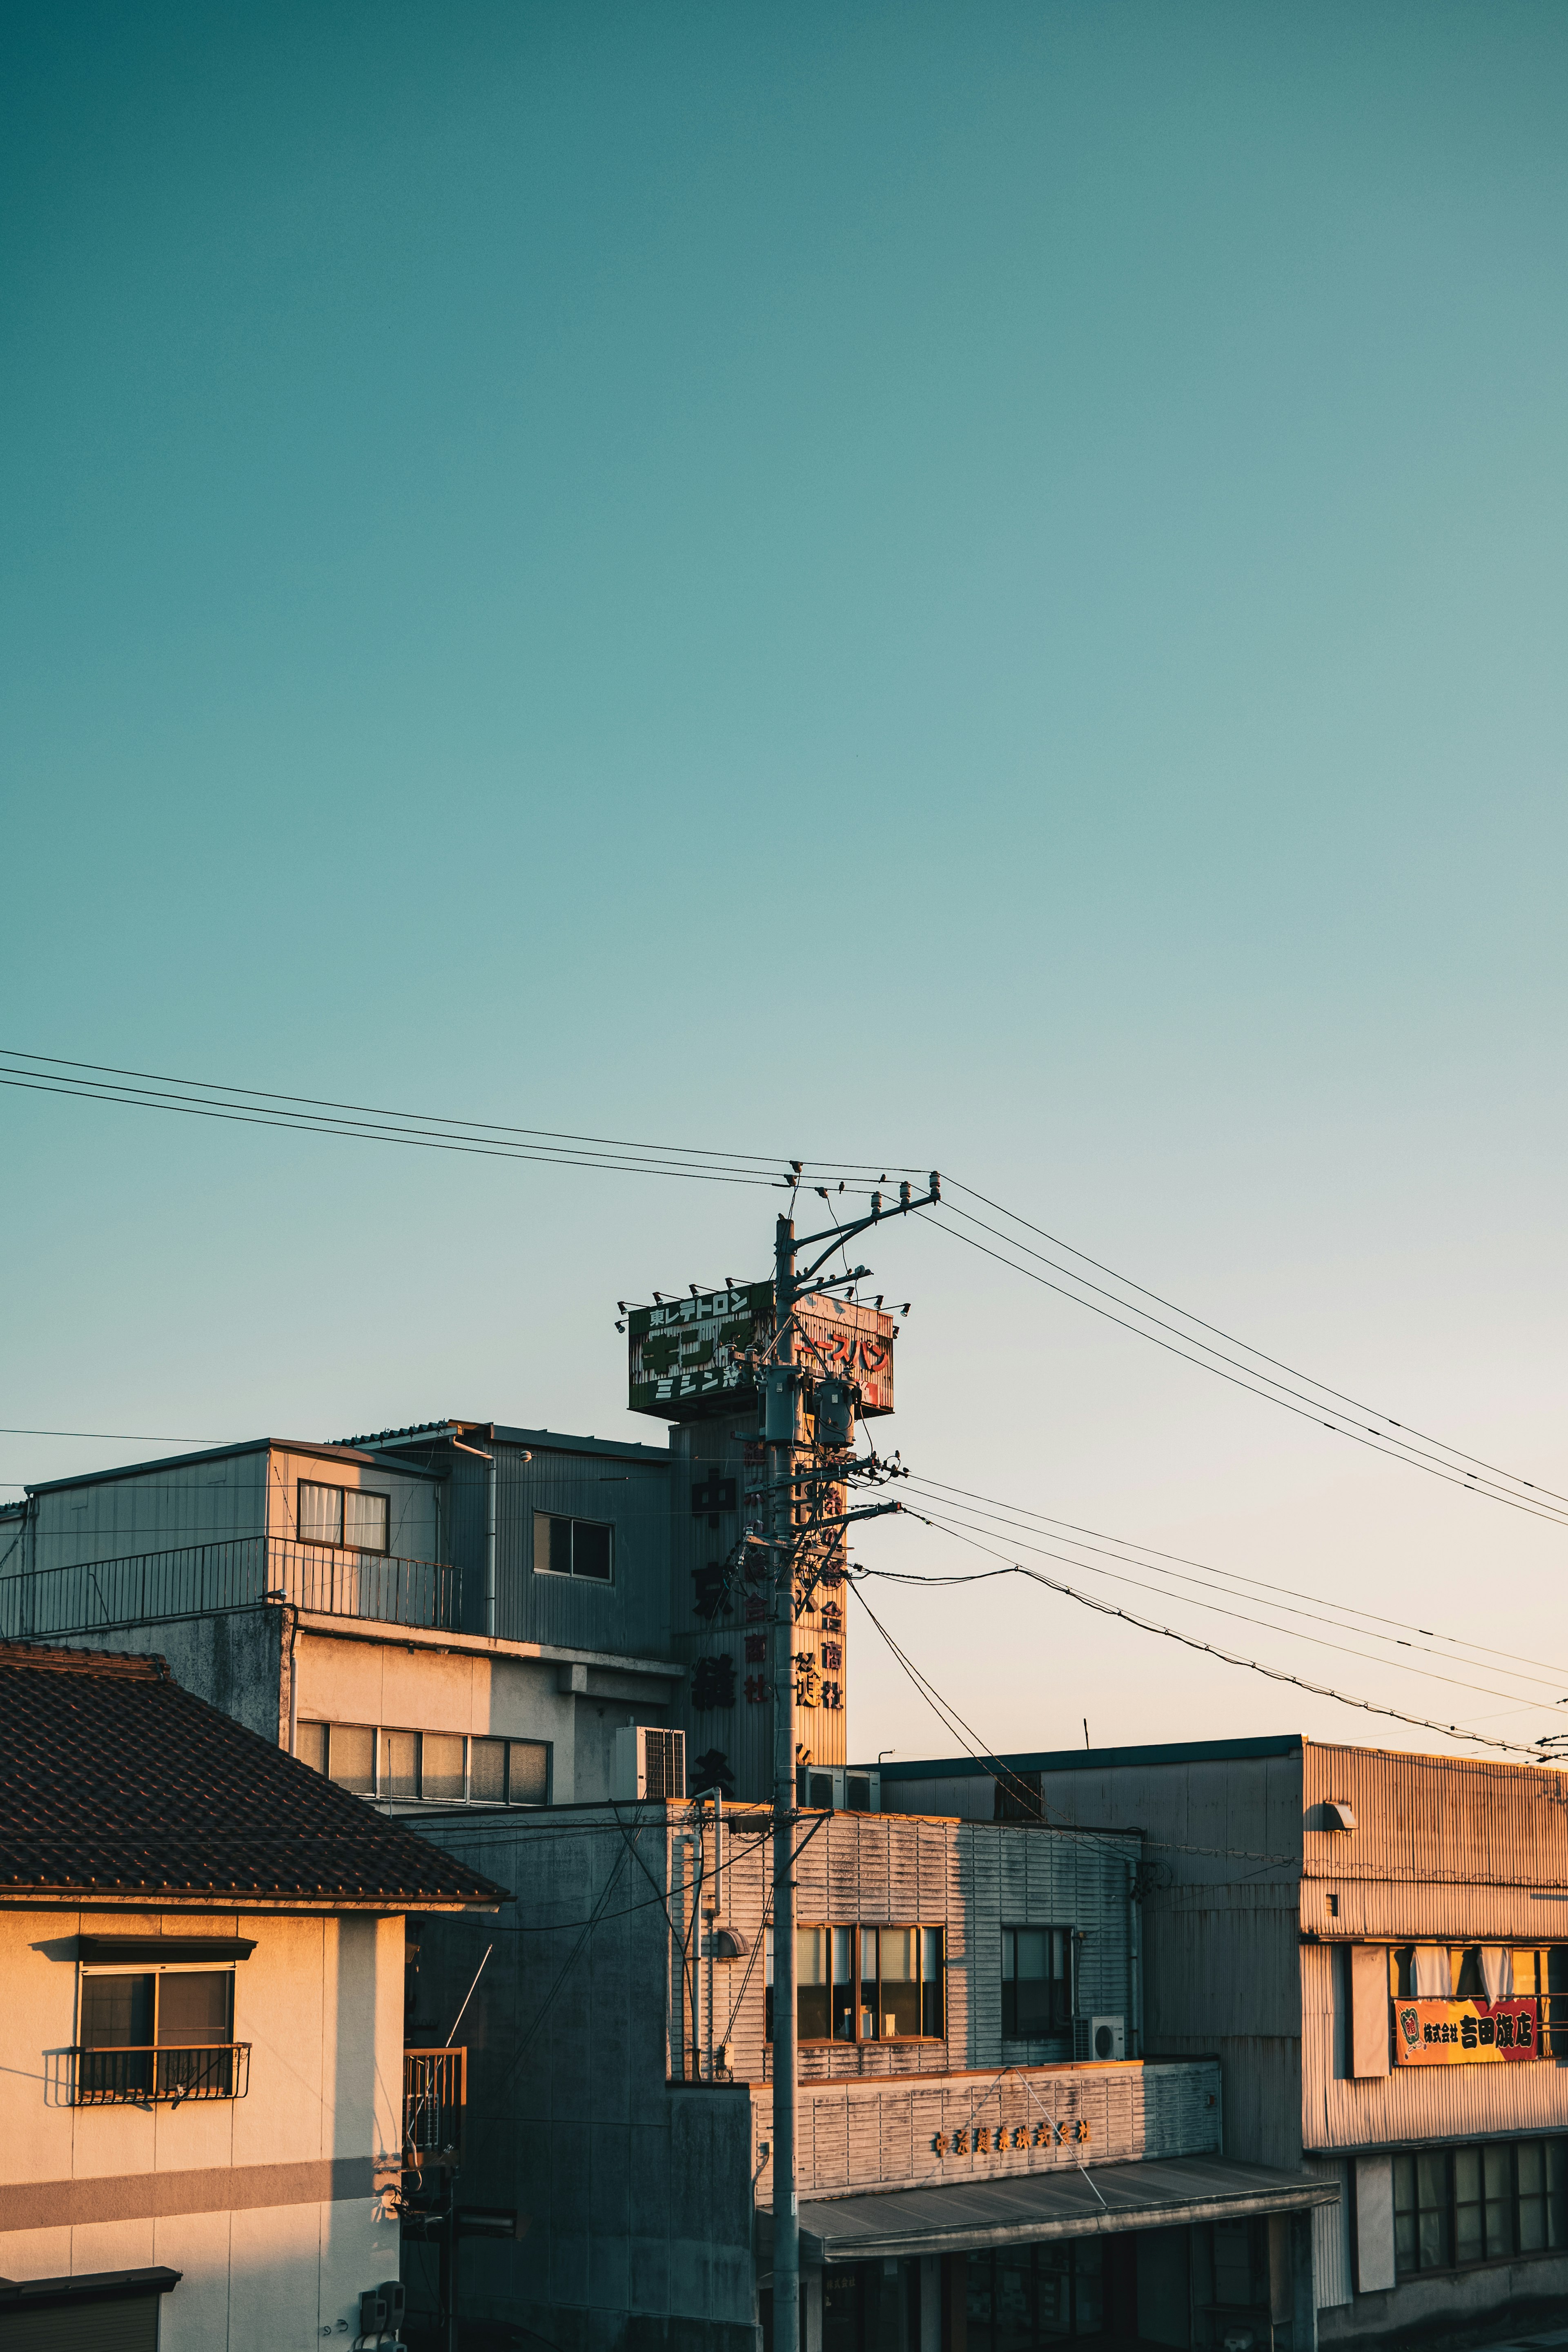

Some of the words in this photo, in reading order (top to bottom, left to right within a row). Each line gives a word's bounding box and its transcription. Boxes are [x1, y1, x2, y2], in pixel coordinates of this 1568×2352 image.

[650, 1291, 747, 1326] 東レテトロン
[821, 1455, 844, 1709] 糸の総合商社
